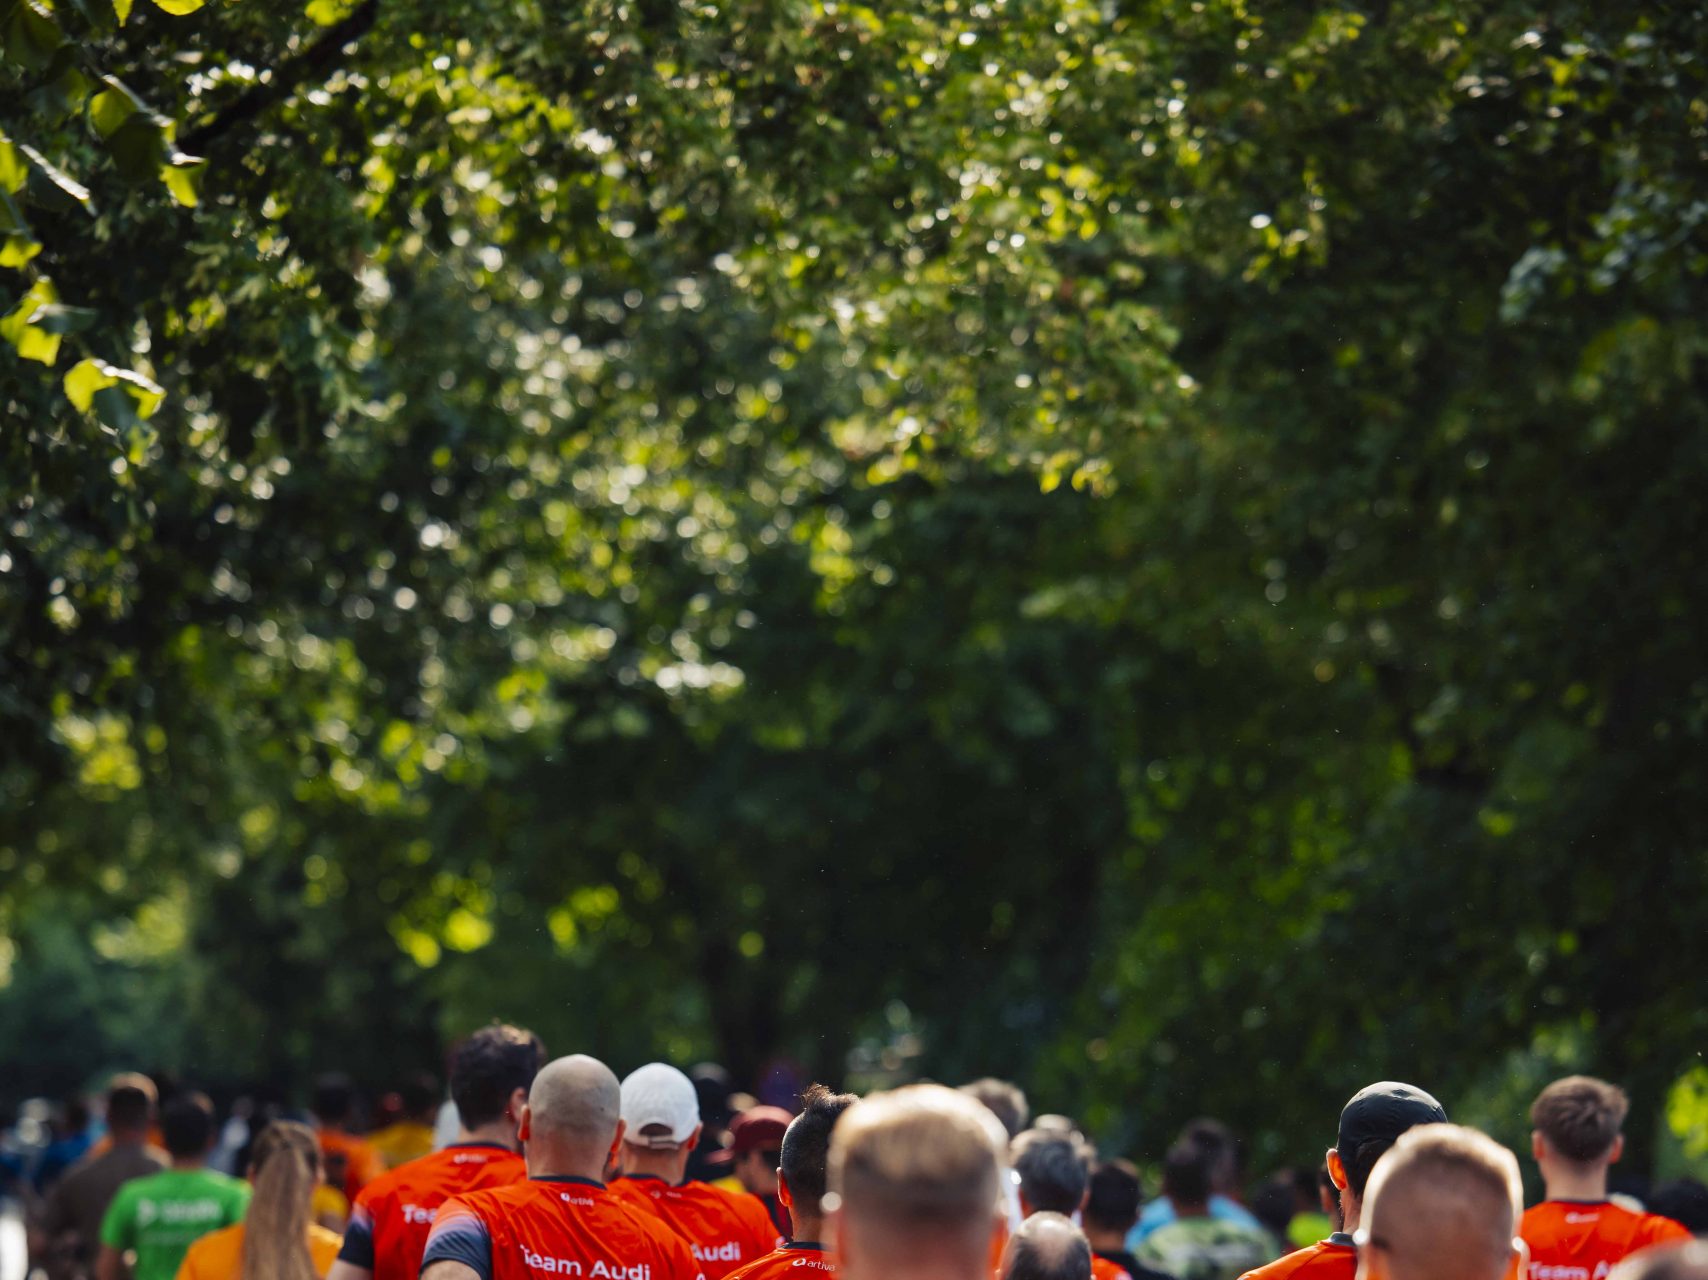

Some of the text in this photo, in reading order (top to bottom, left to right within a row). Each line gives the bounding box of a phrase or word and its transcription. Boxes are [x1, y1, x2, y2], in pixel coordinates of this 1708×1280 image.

[401, 1204, 437, 1224] Tea
[520, 1244, 582, 1276] Team
[807, 1260, 836, 1272] artiva
